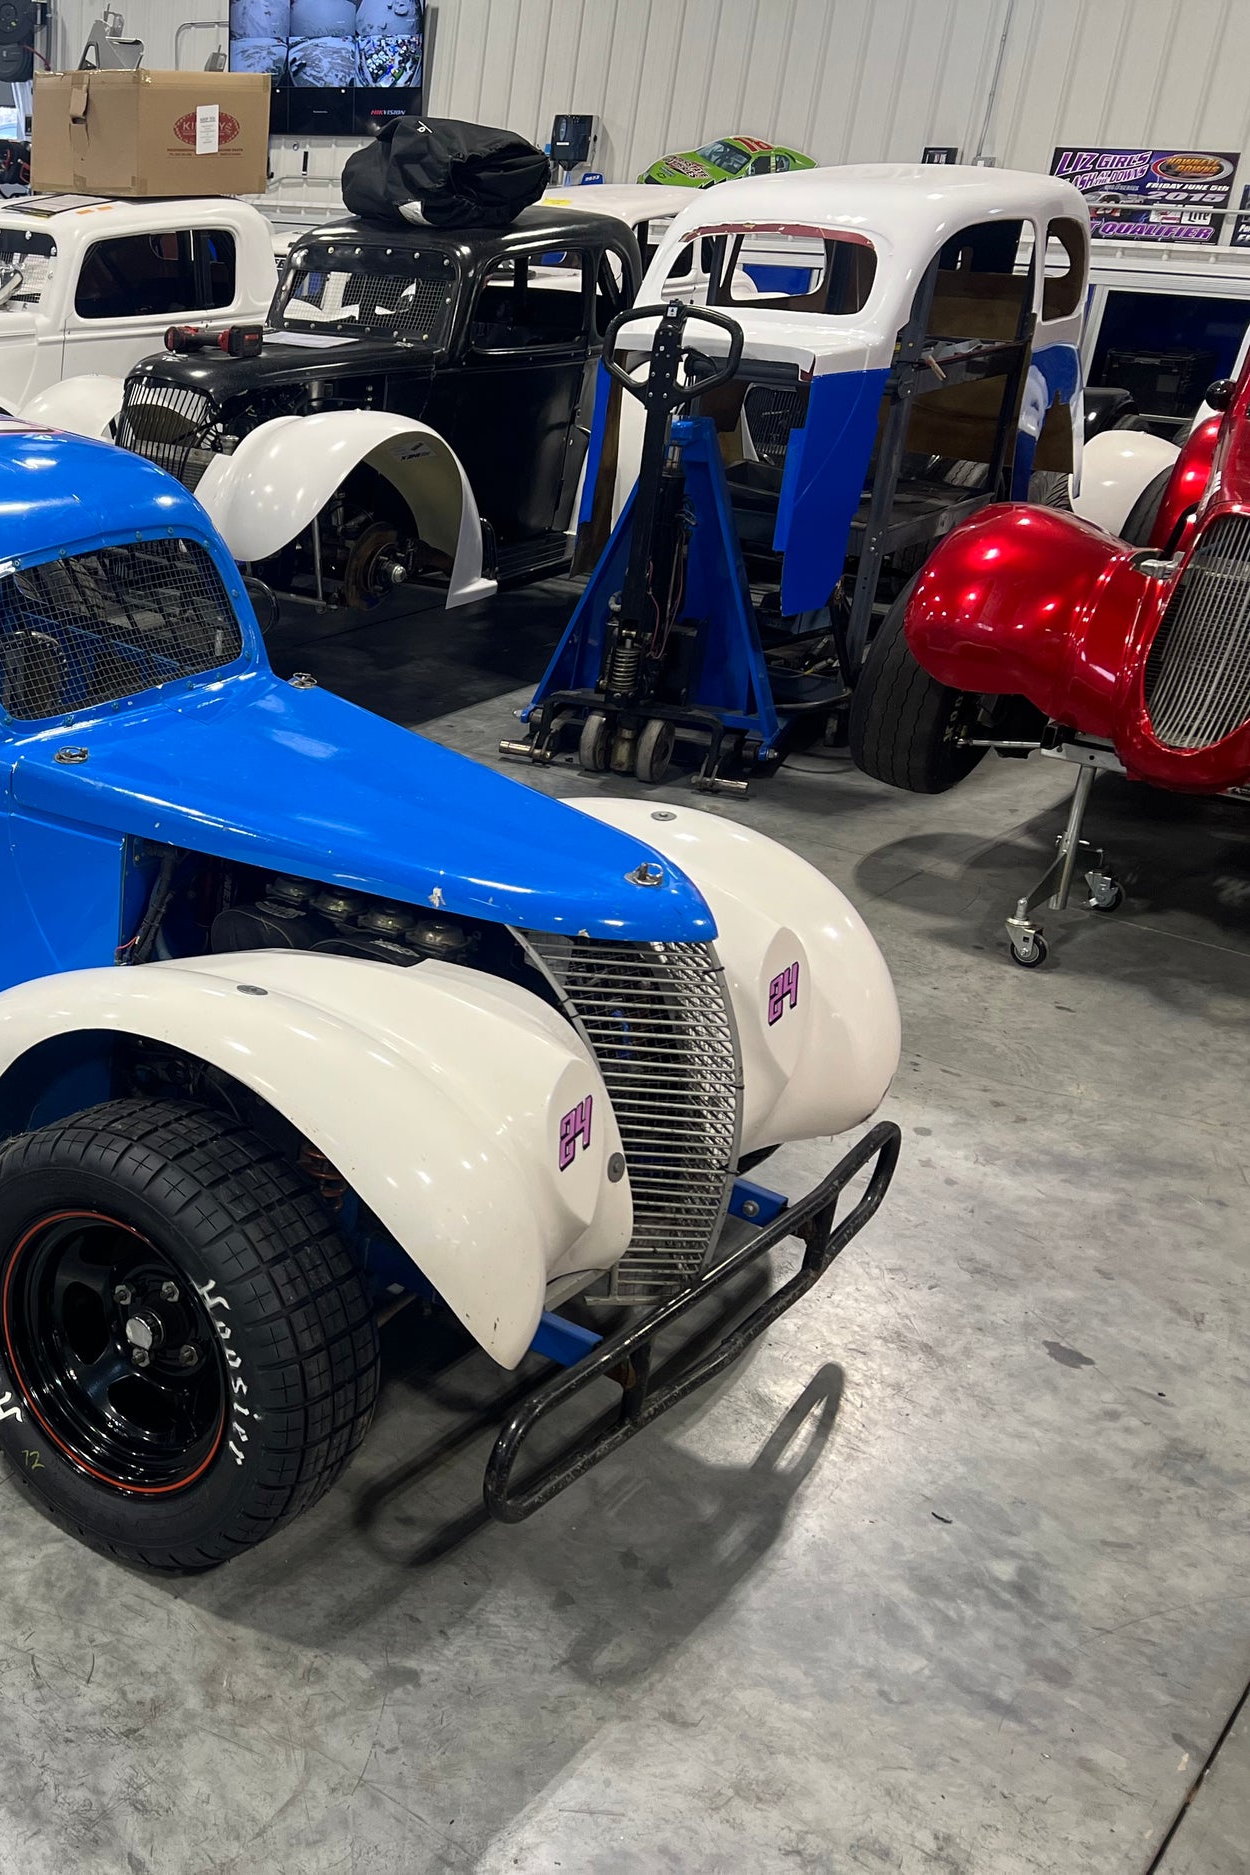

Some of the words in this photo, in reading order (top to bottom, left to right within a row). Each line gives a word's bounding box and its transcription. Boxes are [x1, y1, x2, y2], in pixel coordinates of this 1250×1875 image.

[1055, 152, 1100, 177] LIZ
[1109, 163, 1150, 183] DOWNS
[1176, 164, 1220, 173] DOWNS
[1146, 182, 1183, 190] FRIDAY
[1182, 183, 1209, 191] JUNE
[1147, 191, 1227, 203] 2015
[1099, 221, 1215, 241] QUALIFIER
[768, 961, 799, 1026] 24
[559, 1094, 593, 1172] 24
